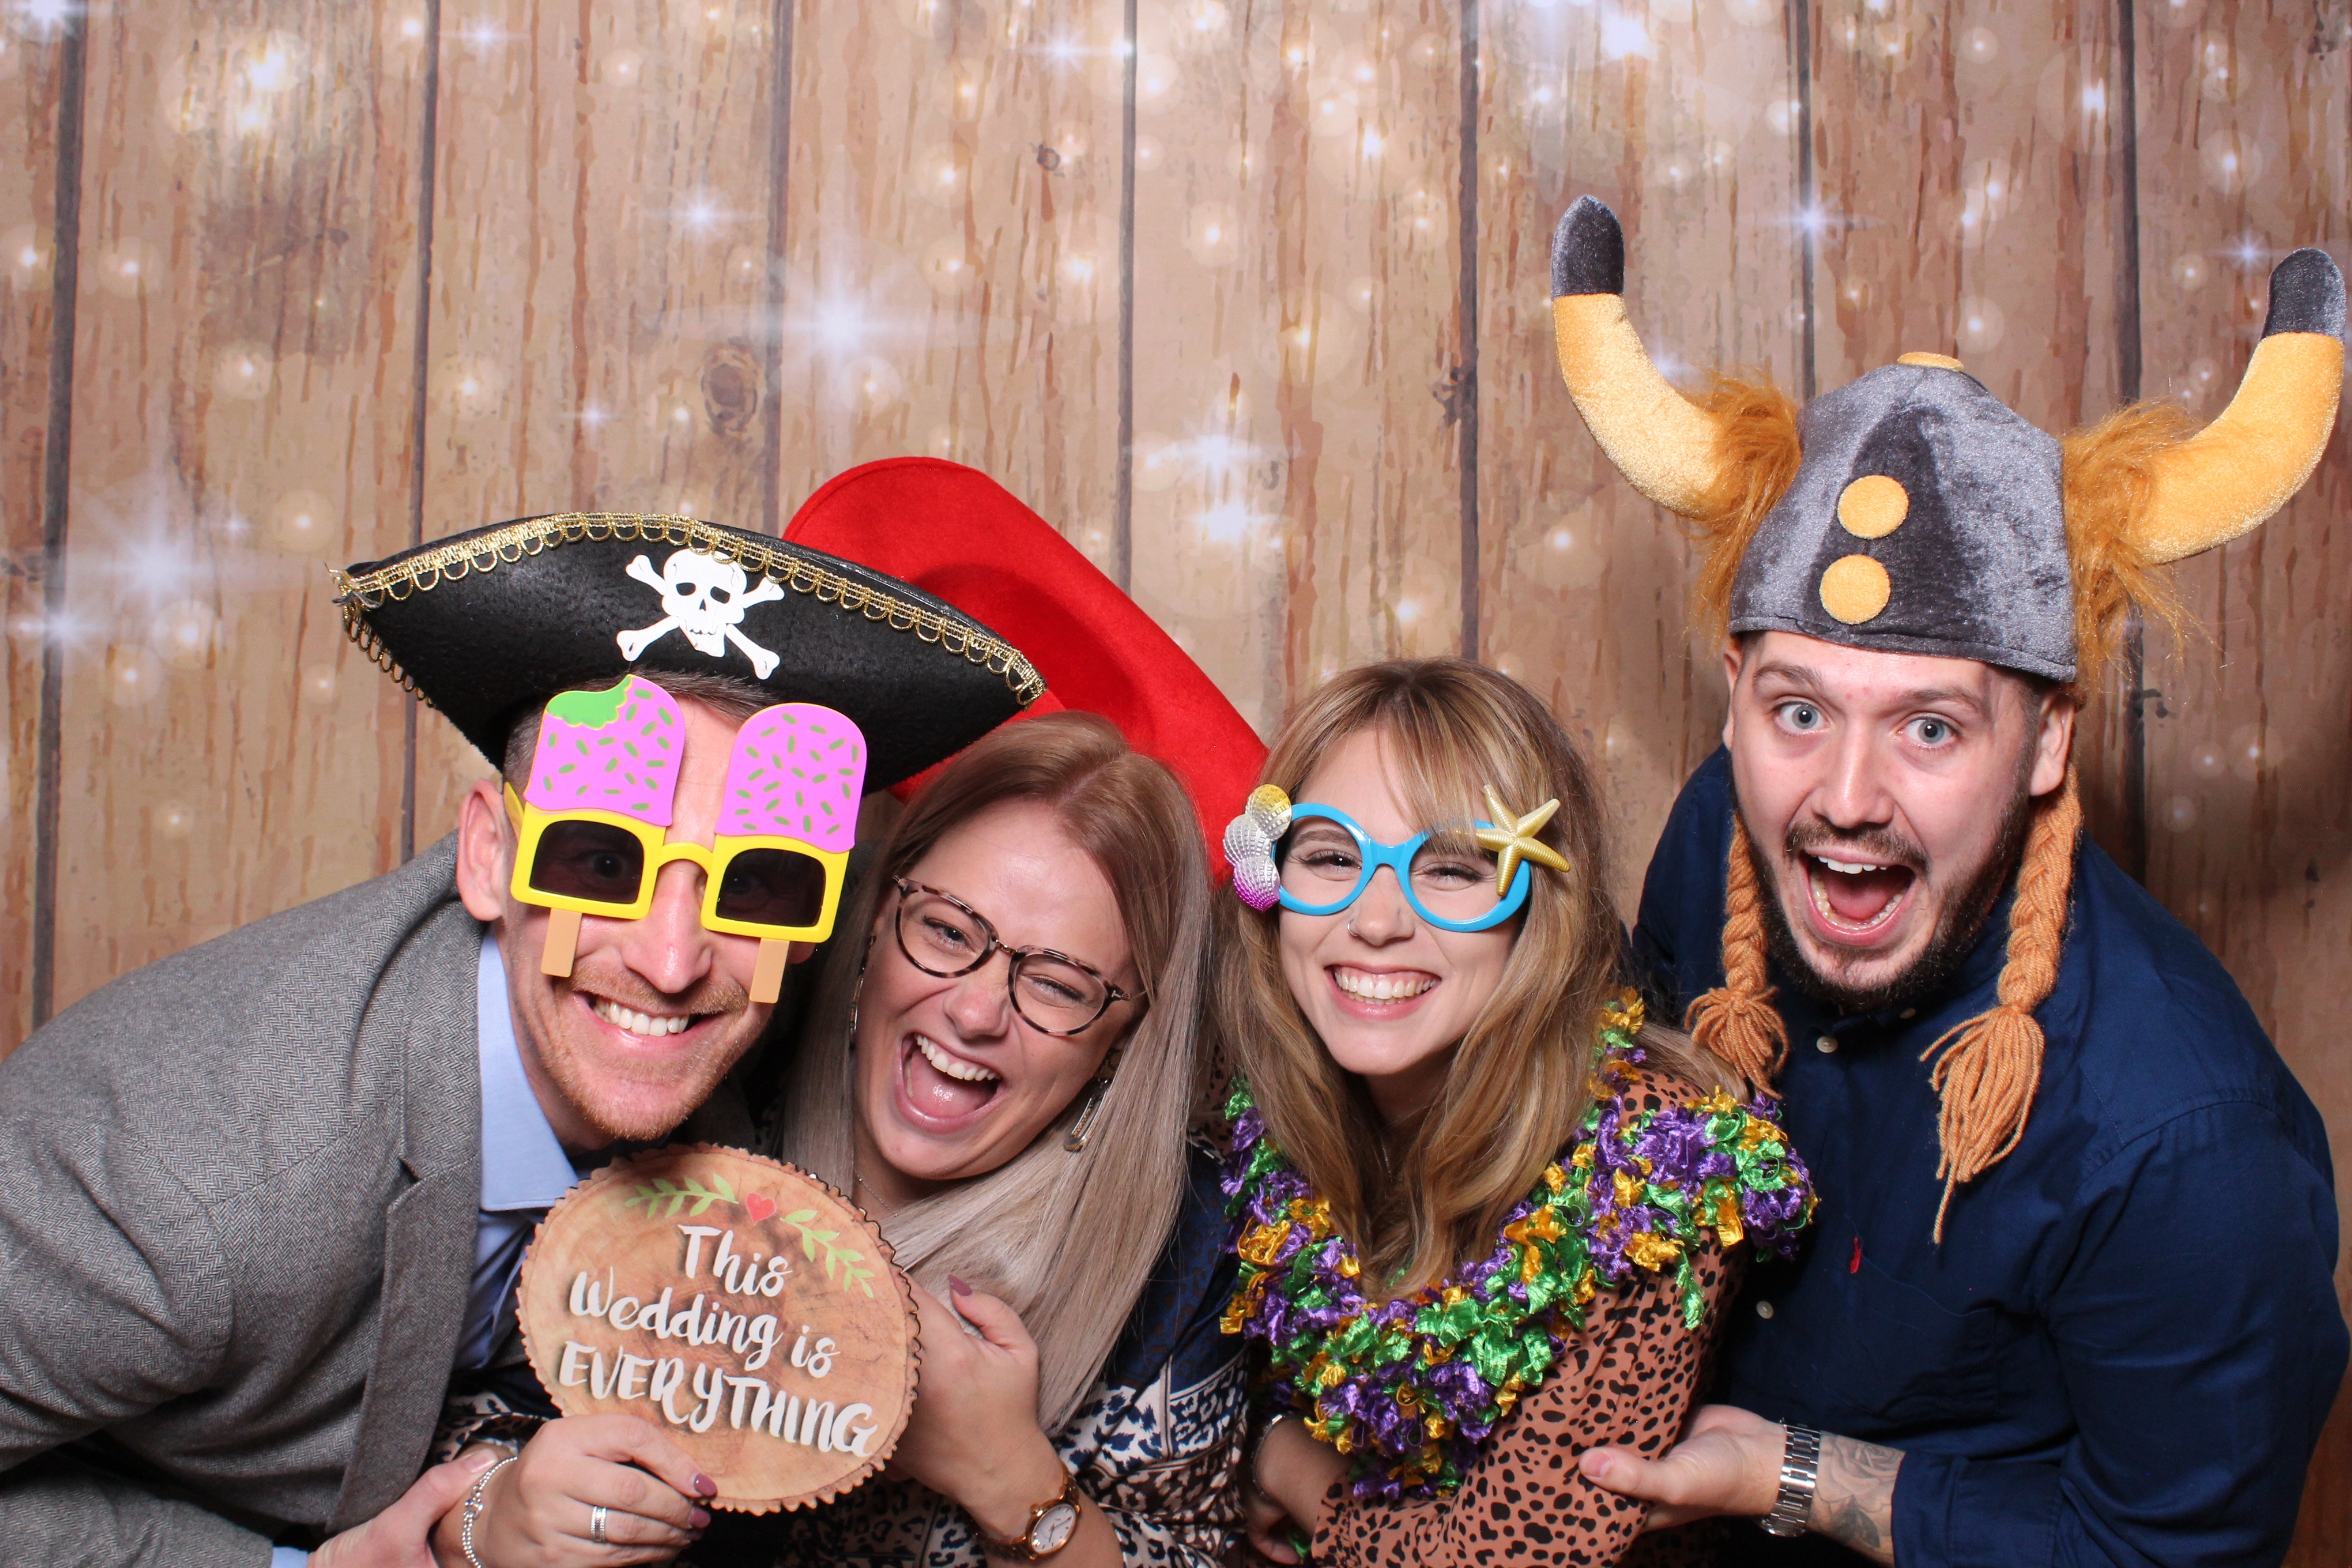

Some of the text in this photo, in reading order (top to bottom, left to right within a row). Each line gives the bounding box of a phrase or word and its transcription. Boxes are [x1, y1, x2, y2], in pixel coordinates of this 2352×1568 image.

[679, 1224, 793, 1297] This
[569, 1267, 841, 1378] Wedding is
[559, 1341, 879, 1457] EVERYTHING
